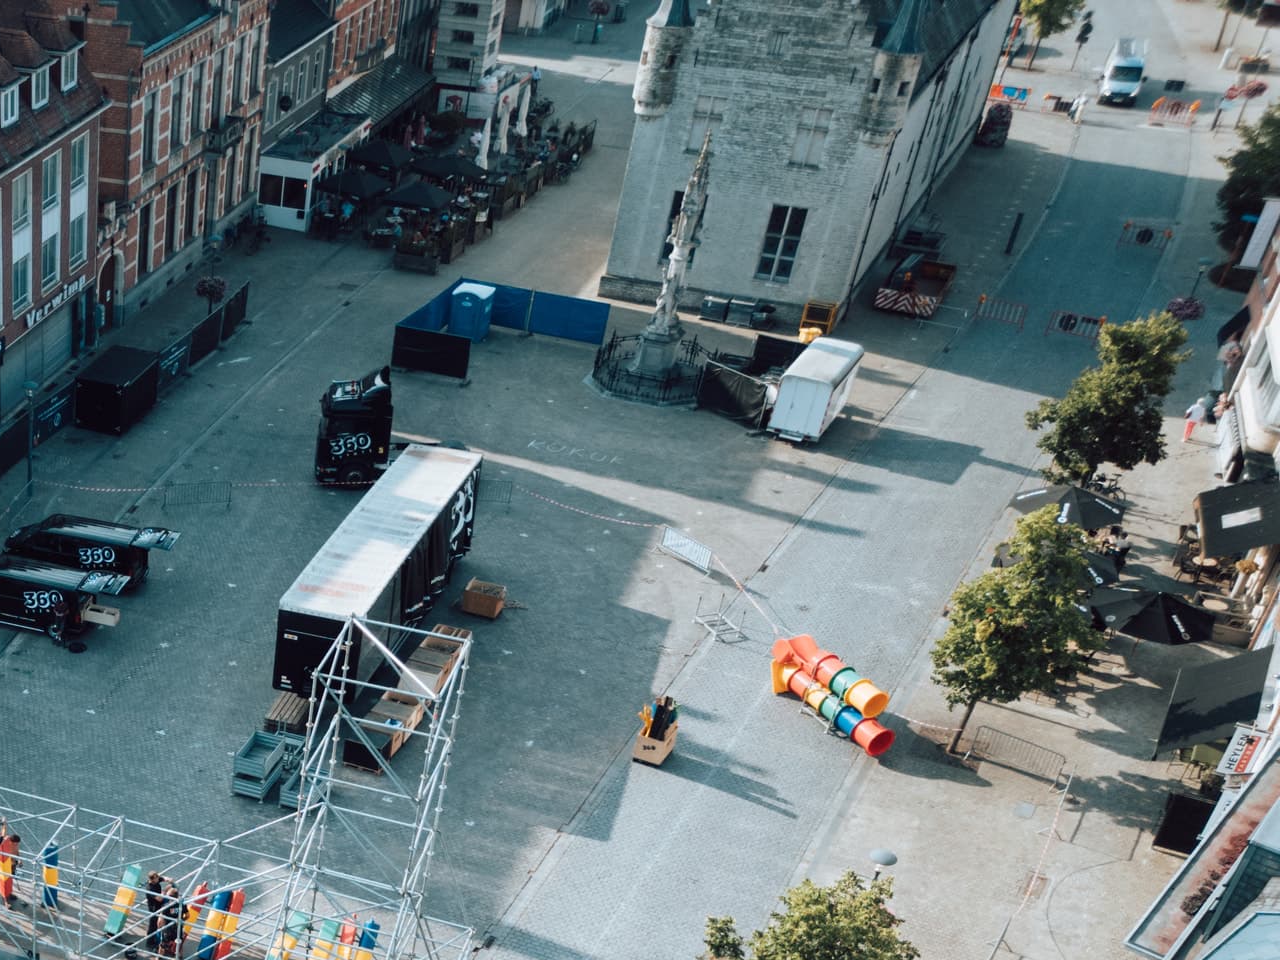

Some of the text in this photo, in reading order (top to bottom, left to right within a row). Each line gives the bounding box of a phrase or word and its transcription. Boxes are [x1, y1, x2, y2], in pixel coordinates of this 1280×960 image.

[26, 275, 86, 329] Verwimp
[329, 433, 371, 455] 360
[79, 546, 115, 564] 360
[24, 590, 64, 608] 360
[1225, 734, 1249, 769] HEYLEN
